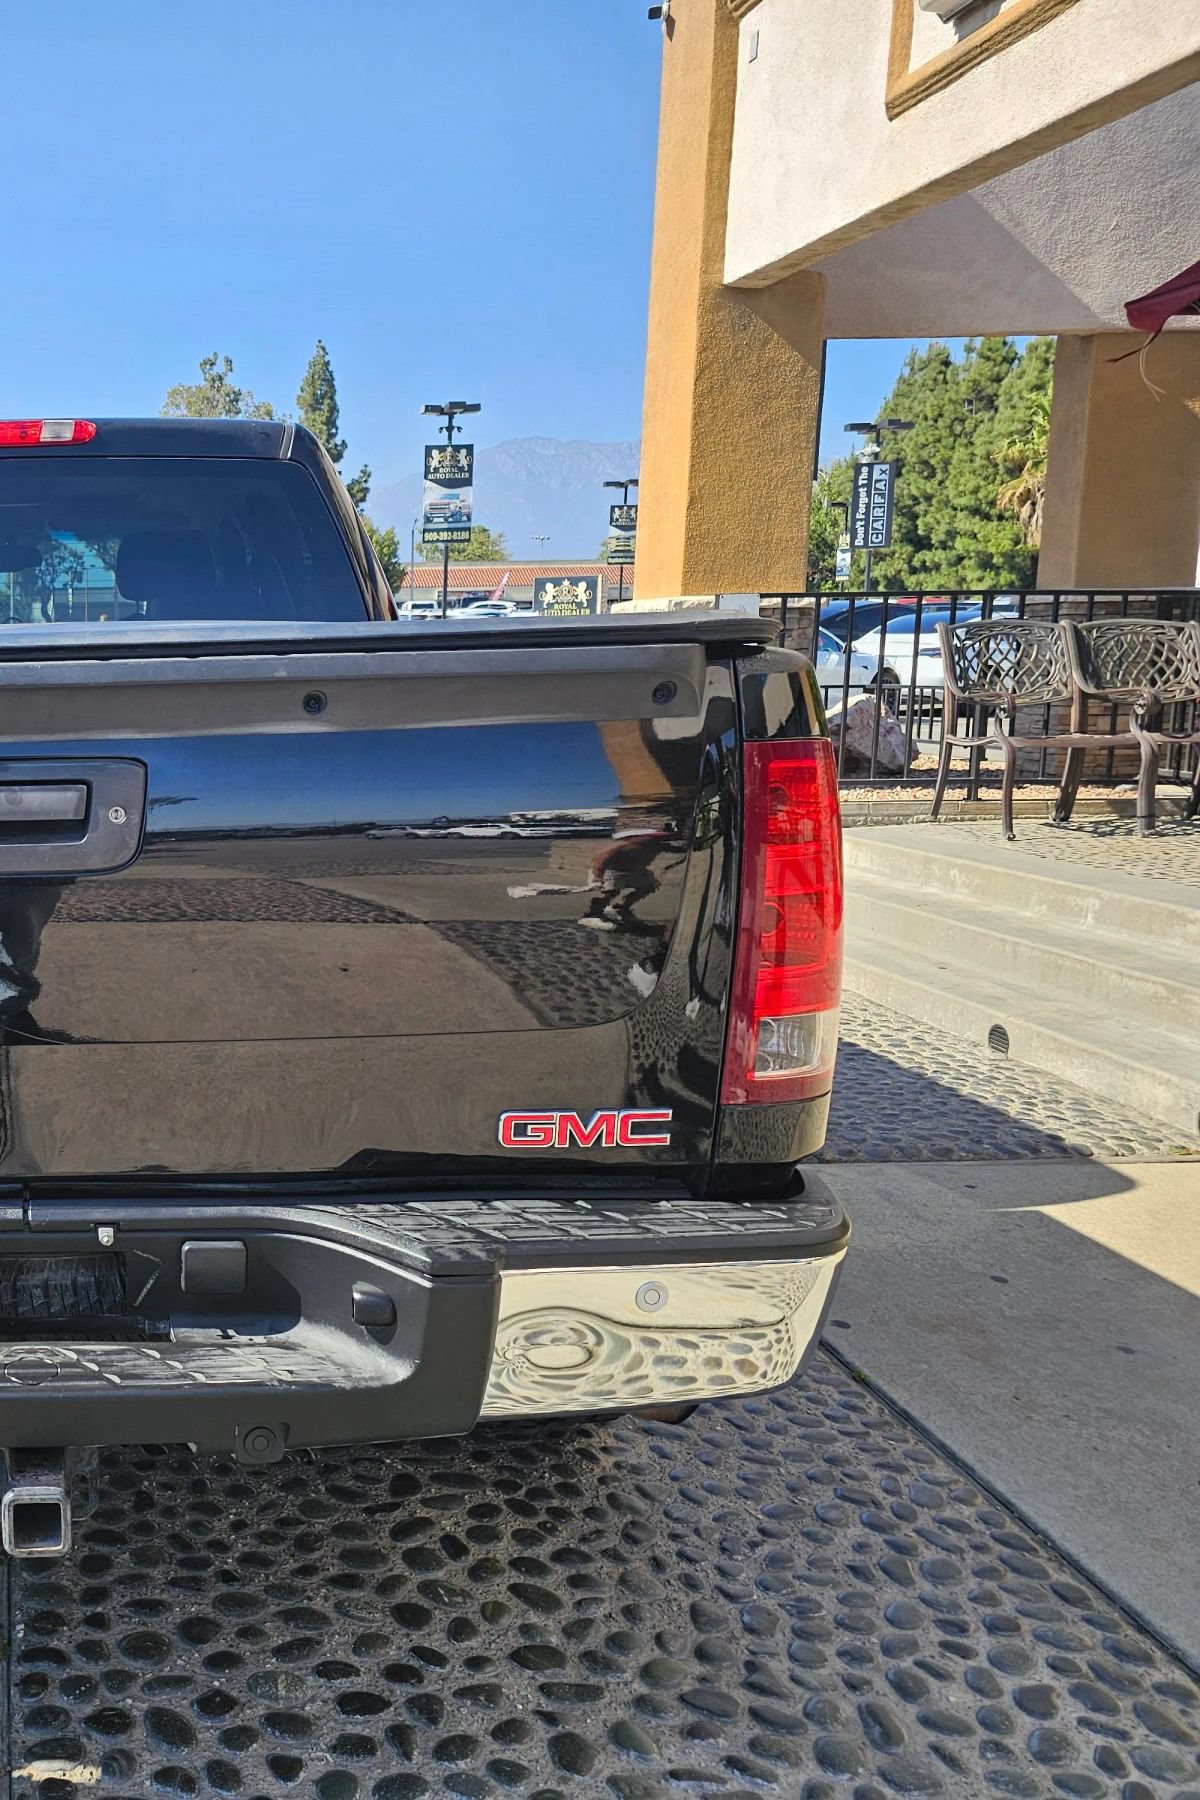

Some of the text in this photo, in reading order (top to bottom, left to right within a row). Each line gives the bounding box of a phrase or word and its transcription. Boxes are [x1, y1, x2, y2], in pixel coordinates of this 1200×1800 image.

[855, 466, 869, 546] Don't Forget The
[871, 468, 888, 543] CARFAX
[562, 608, 590, 616] DEALER
[499, 1107, 672, 1148] GMC
